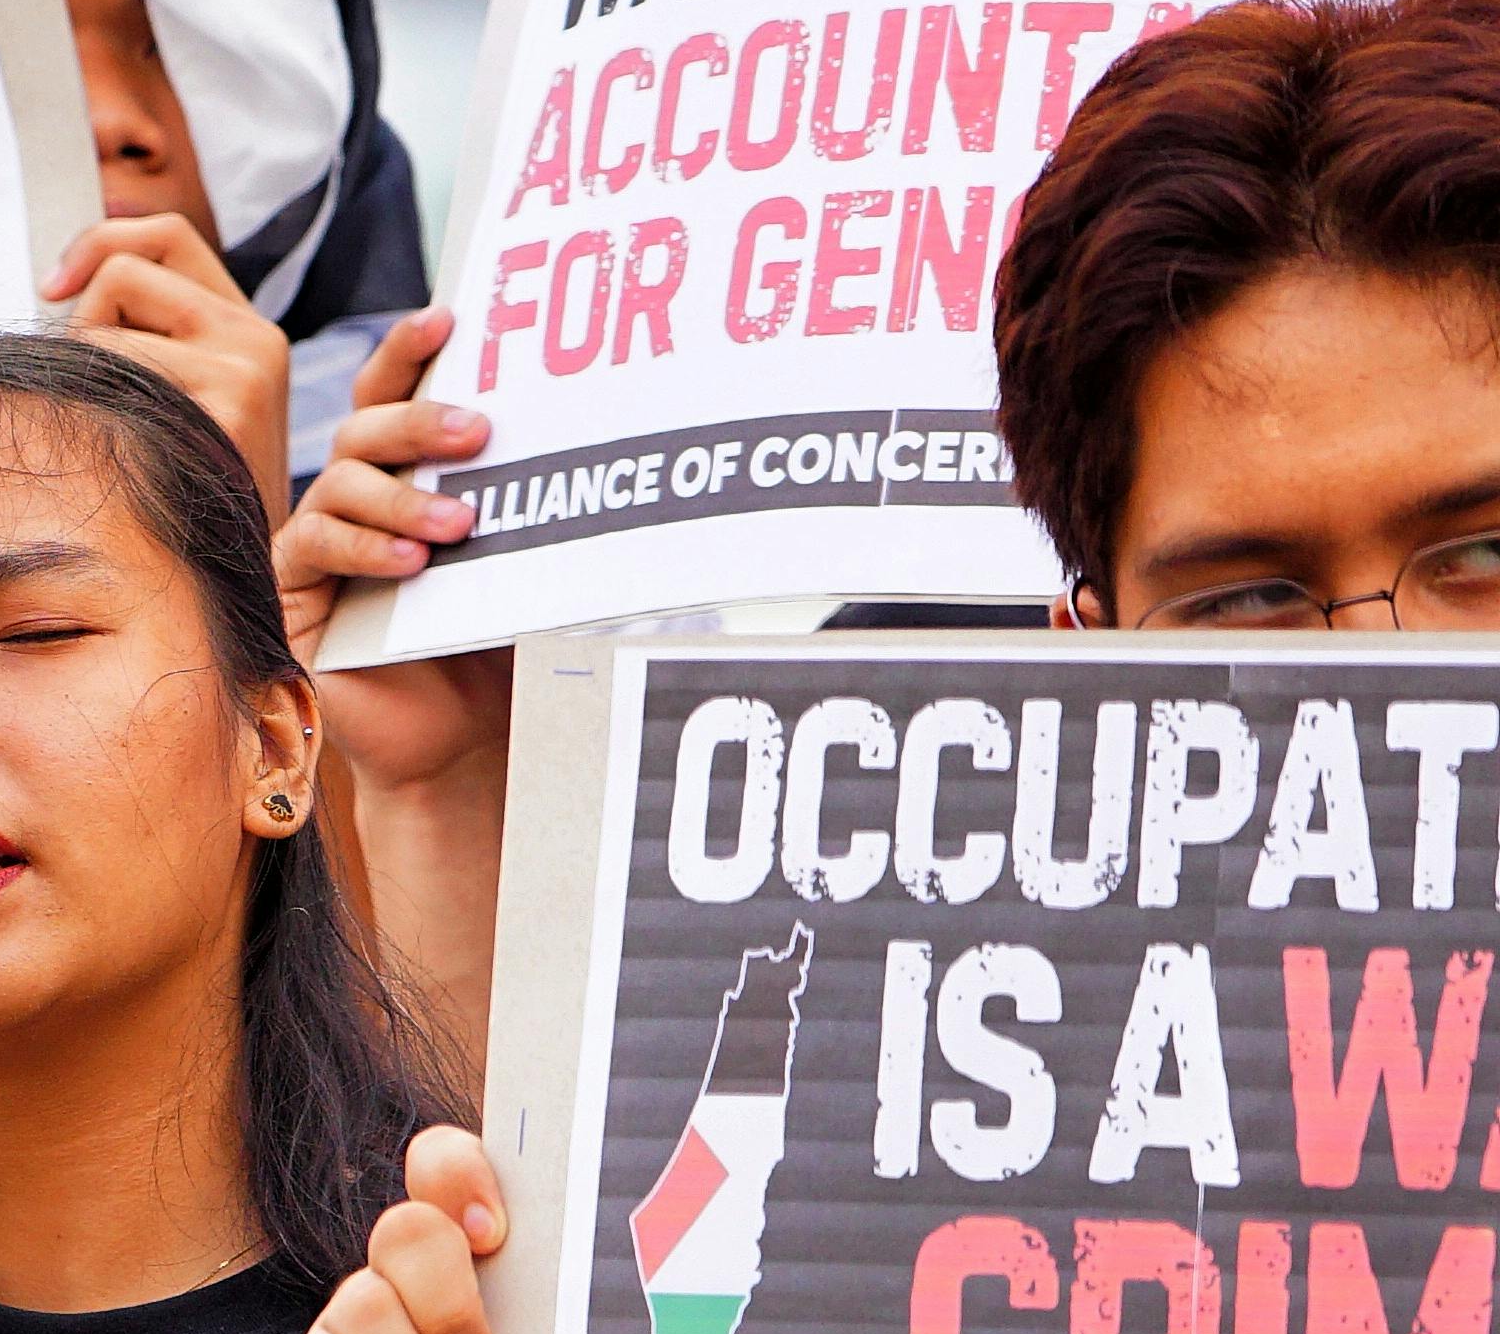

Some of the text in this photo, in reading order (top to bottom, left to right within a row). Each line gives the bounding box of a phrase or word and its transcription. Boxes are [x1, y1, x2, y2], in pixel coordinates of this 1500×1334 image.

[504, 1, 1194, 219] ACCOUNT
[477, 186, 1025, 393] FOR GEN
[671, 440, 742, 498] OF
[667, 696, 1500, 914] OCCUPAT
[873, 938, 1500, 1193] IS A W
